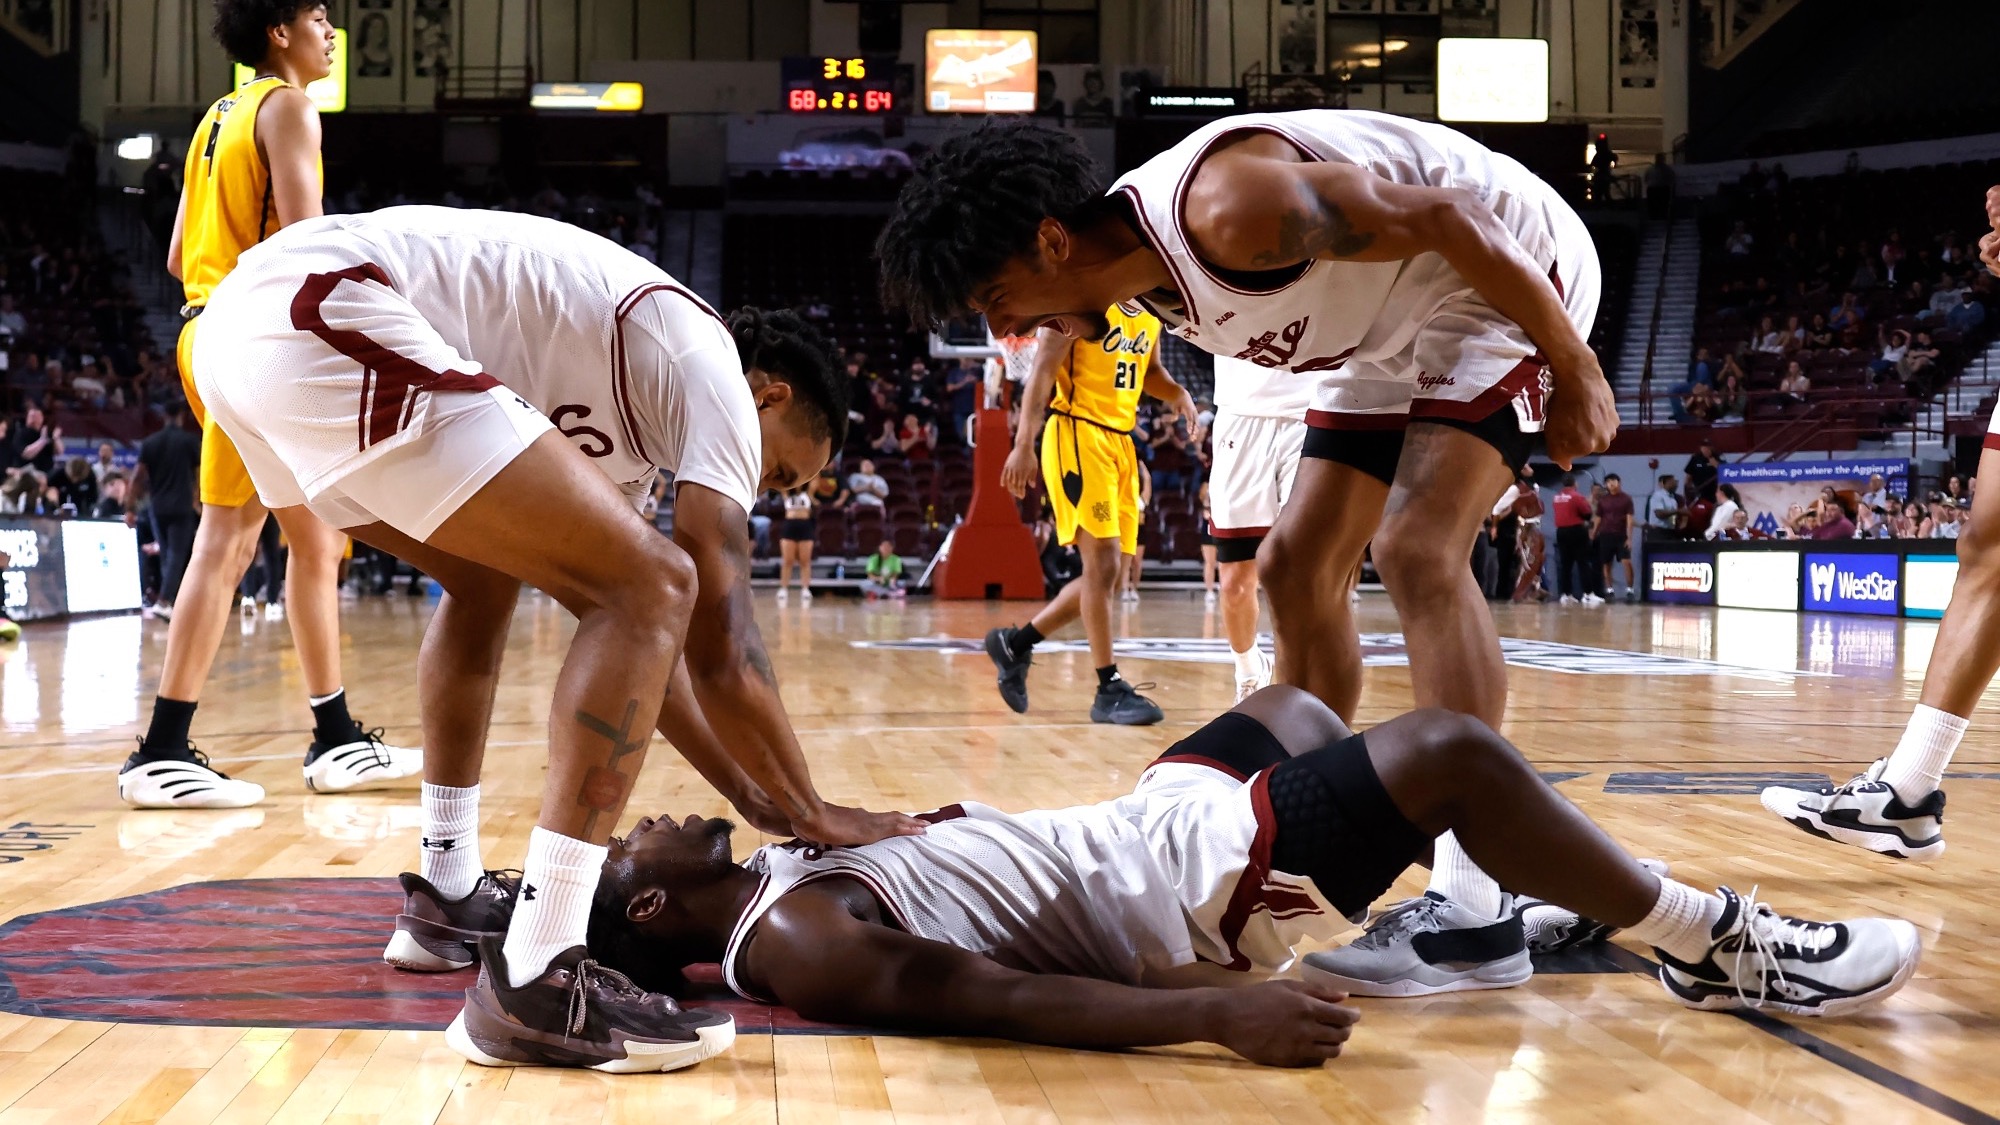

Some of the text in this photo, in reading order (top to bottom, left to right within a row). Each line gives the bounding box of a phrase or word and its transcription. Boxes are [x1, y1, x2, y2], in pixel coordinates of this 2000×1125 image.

[824, 58, 865, 79] 3:16
[790, 90, 816, 110] 68
[865, 90, 892, 110] 64
[1103, 326, 1150, 355] Owls
[1114, 360, 1137, 390] 21
[1723, 462, 1904, 479] For healthcare, go where the Aggies go!
[1838, 571, 1897, 601] WestStar
